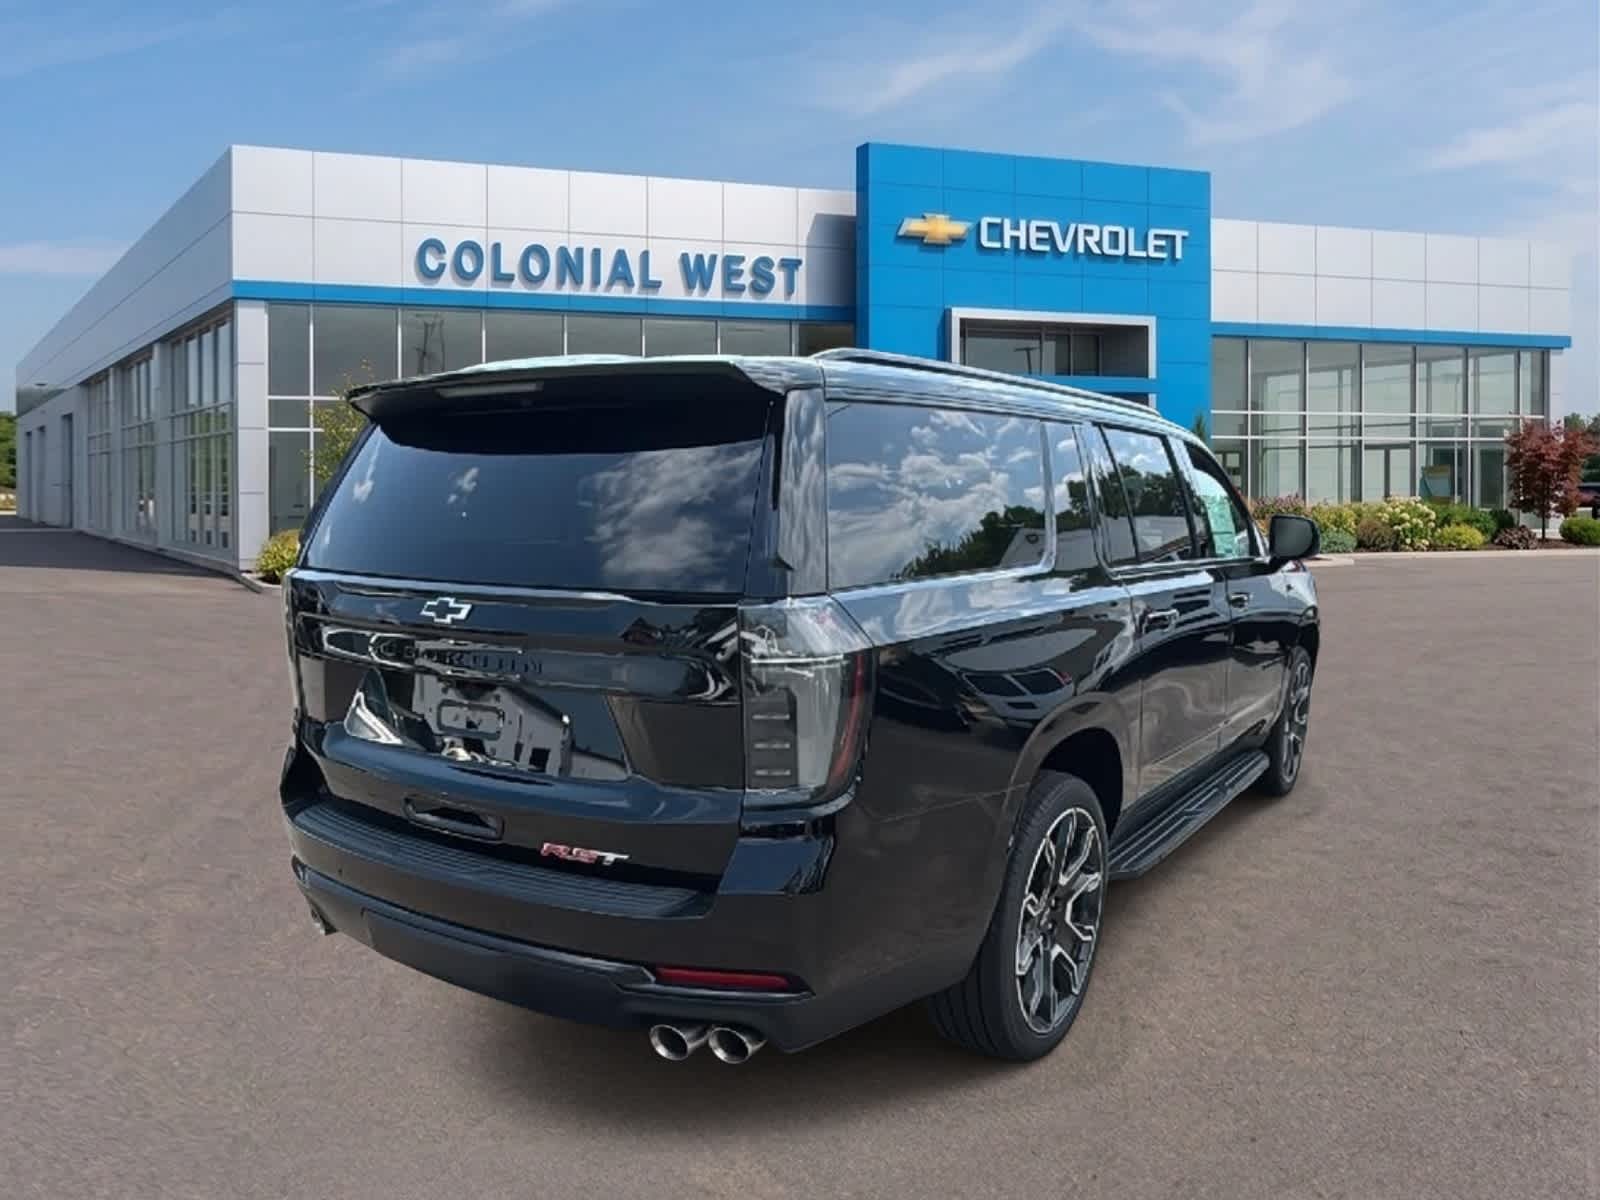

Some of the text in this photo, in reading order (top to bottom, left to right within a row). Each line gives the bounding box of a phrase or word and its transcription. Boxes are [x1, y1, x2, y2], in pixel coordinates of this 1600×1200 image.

[979, 216, 1189, 260] CHEVROLET
[416, 238, 802, 296] COLONIAL WEST
[541, 842, 630, 866] RST
